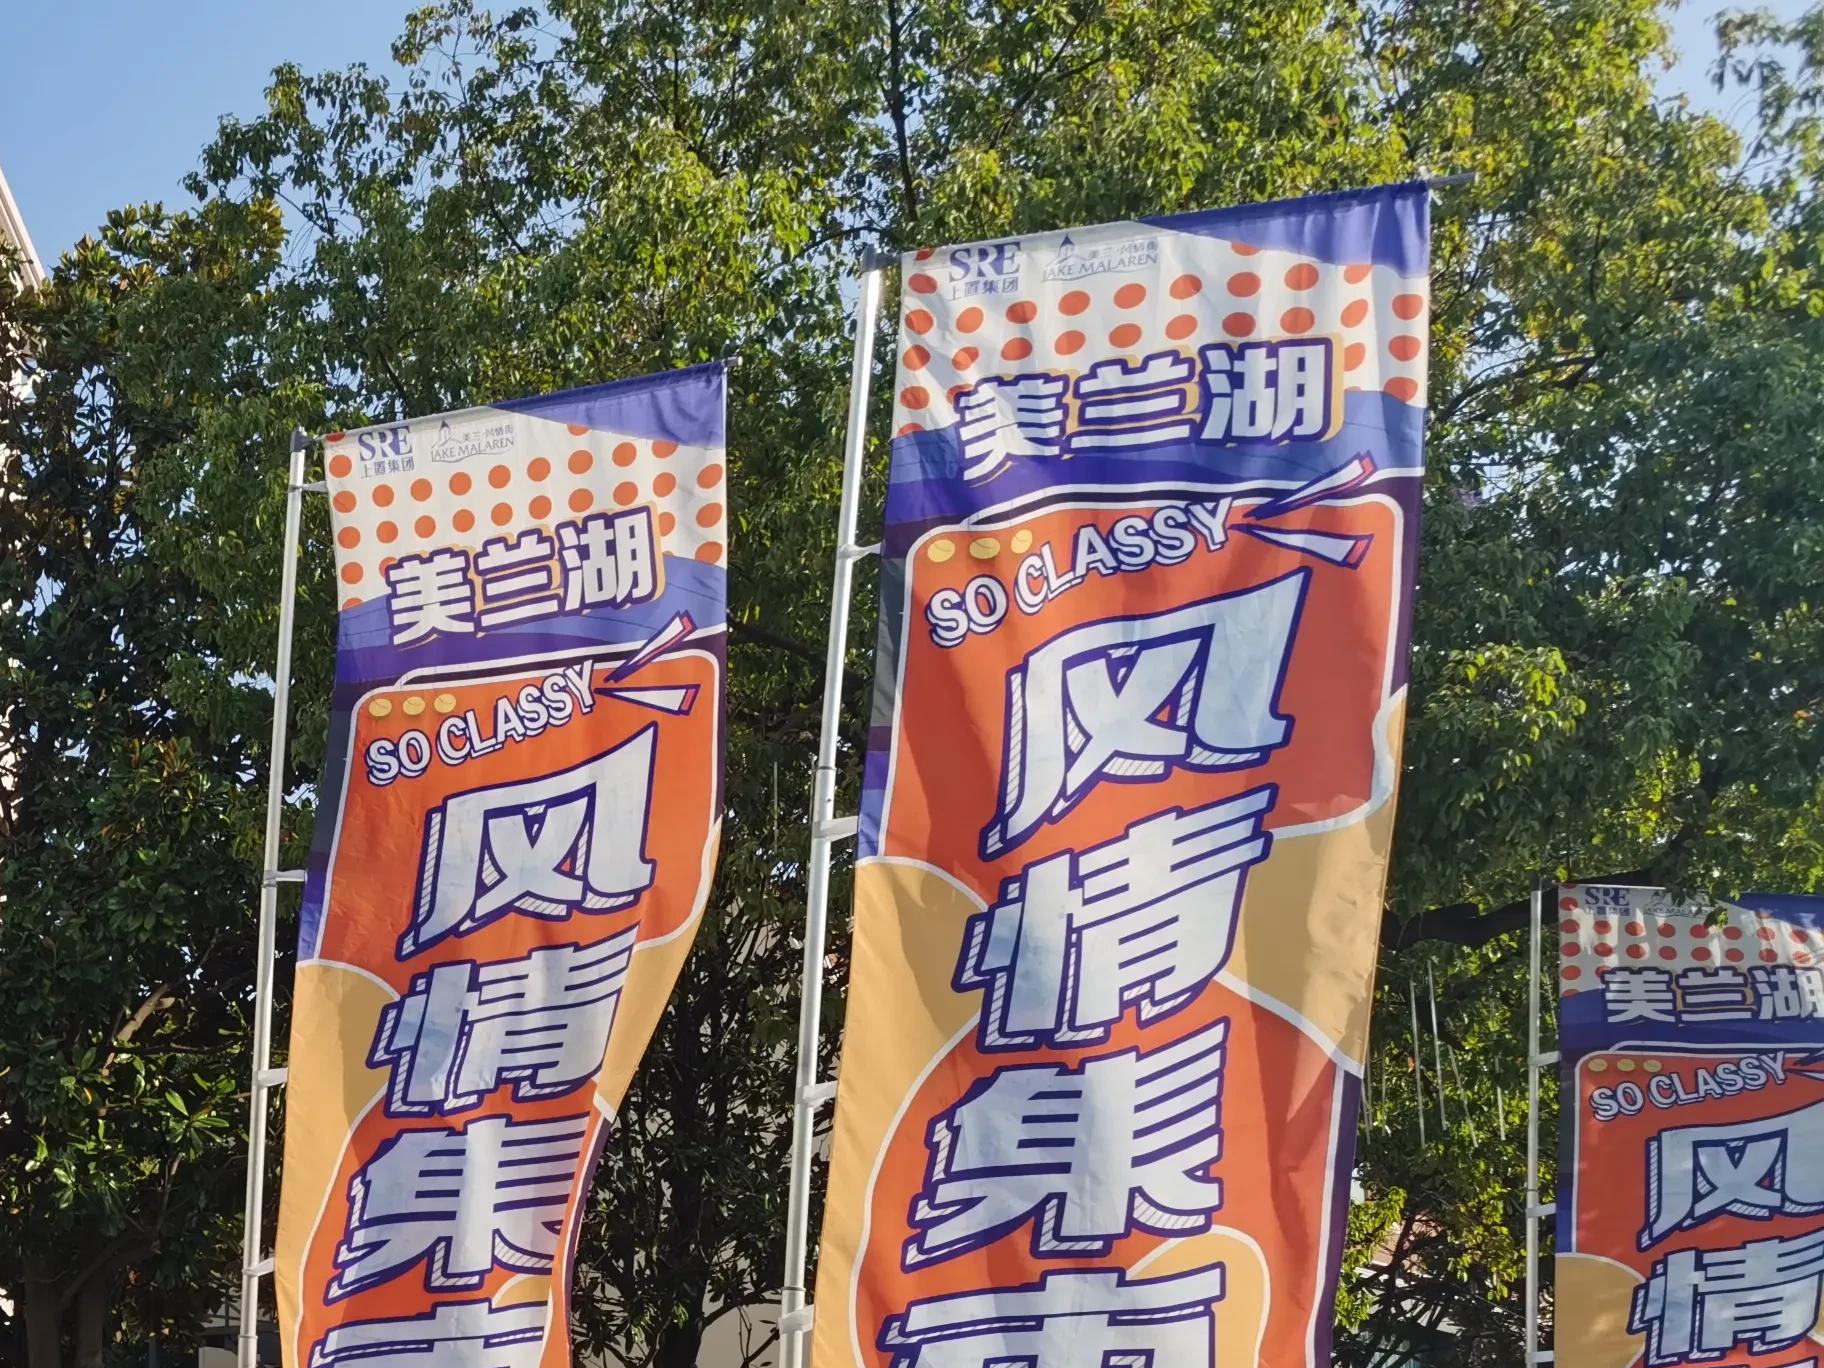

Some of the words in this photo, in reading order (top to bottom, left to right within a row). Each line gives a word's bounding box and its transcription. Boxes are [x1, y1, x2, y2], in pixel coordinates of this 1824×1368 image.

[949, 242, 1021, 282] SRE
[1079, 253, 1159, 274] MALAREN
[953, 336, 1334, 482] 美兰湖
[358, 425, 413, 461] SRE
[458, 437, 514, 457] MALAREN
[387, 505, 658, 647] 美兰湖
[925, 574, 1008, 647] SO
[1015, 496, 1234, 614] CLASSY
[366, 728, 431, 784] SO
[438, 659, 597, 765] CLASSY
[1585, 886, 1630, 907] SRE
[1601, 966, 1824, 1023] 美兰湖
[1591, 1081, 1644, 1121] SO
[1648, 1051, 1786, 1109] CLASSY
